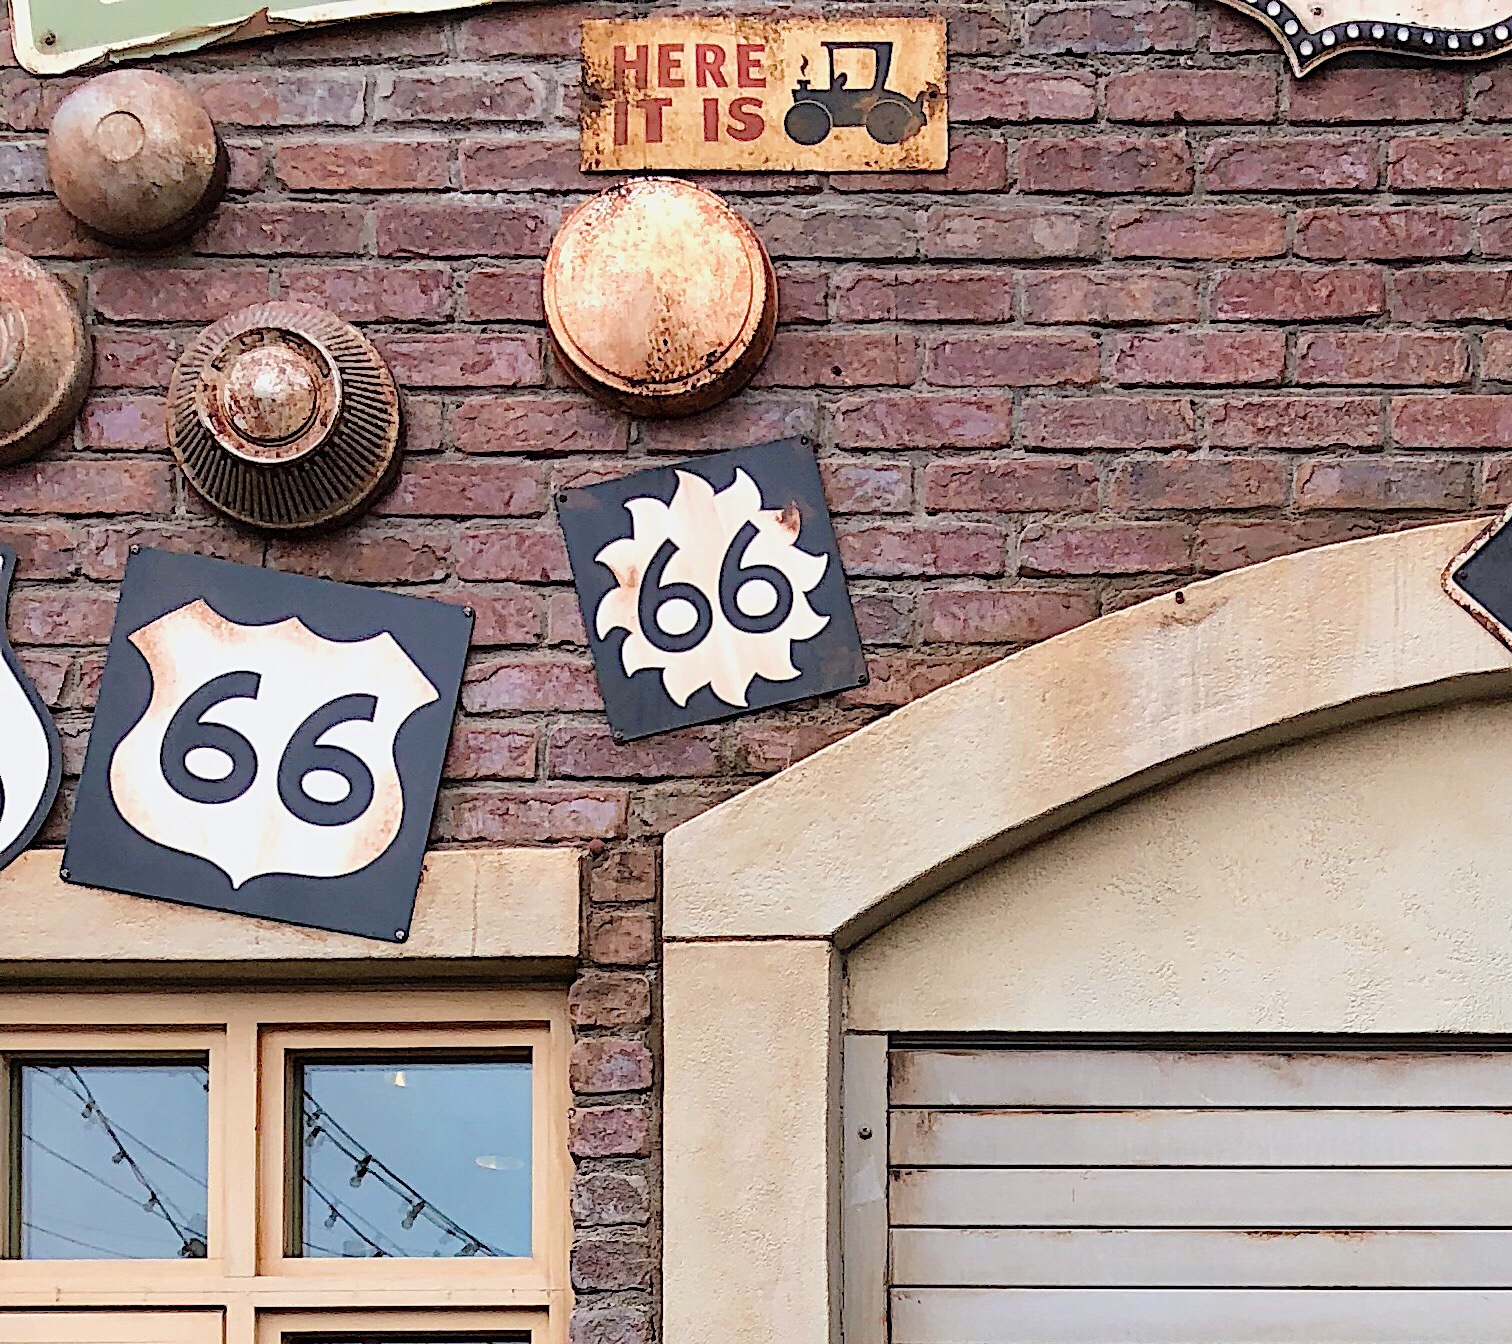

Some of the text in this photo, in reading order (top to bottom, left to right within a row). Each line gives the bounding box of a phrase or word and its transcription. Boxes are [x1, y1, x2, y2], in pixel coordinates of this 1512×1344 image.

[613, 43, 766, 90] HERE
[613, 97, 765, 146] IT IS
[638, 519, 795, 652] 66
[160, 670, 378, 827] 66
